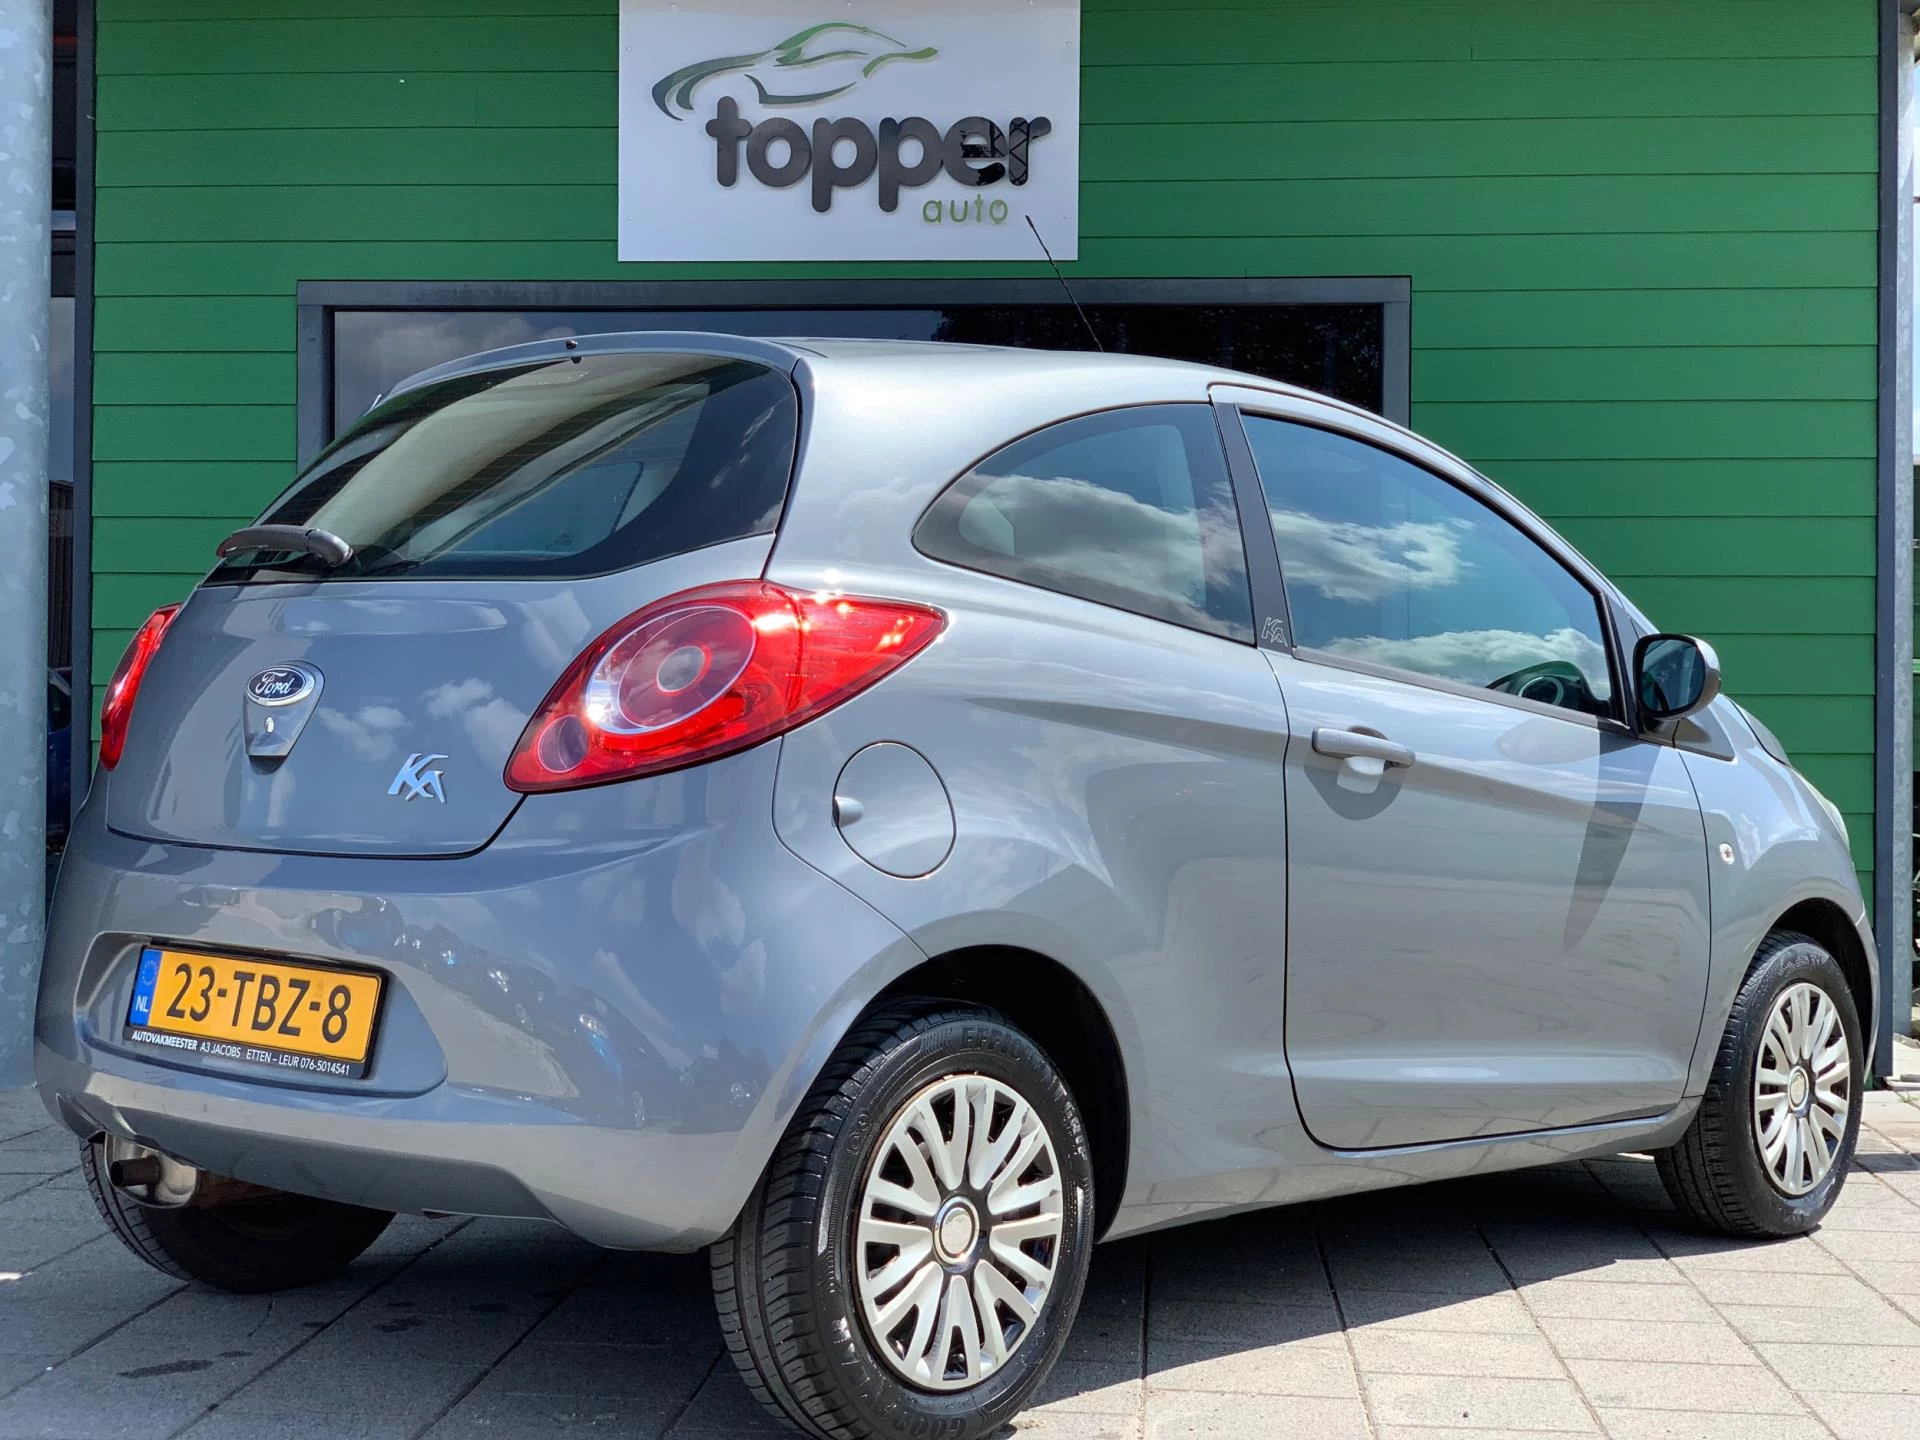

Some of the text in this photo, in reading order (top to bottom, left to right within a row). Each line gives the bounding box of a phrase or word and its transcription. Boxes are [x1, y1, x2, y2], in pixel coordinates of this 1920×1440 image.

[705, 96, 1052, 213] topper
[922, 194, 1008, 224] auto
[255, 671, 295, 695] Ford
[135, 995, 149, 1013] NL
[166, 963, 351, 1044] 23-TBZ-8
[131, 1030, 198, 1050] AUTOVAKMEESTER
[200, 1041, 211, 1052] A3
[211, 1043, 241, 1058] JACOBS
[246, 1049, 272, 1064] ETTEN
[279, 1054, 300, 1067] LEUR
[300, 1057, 350, 1076] 076-5014541
